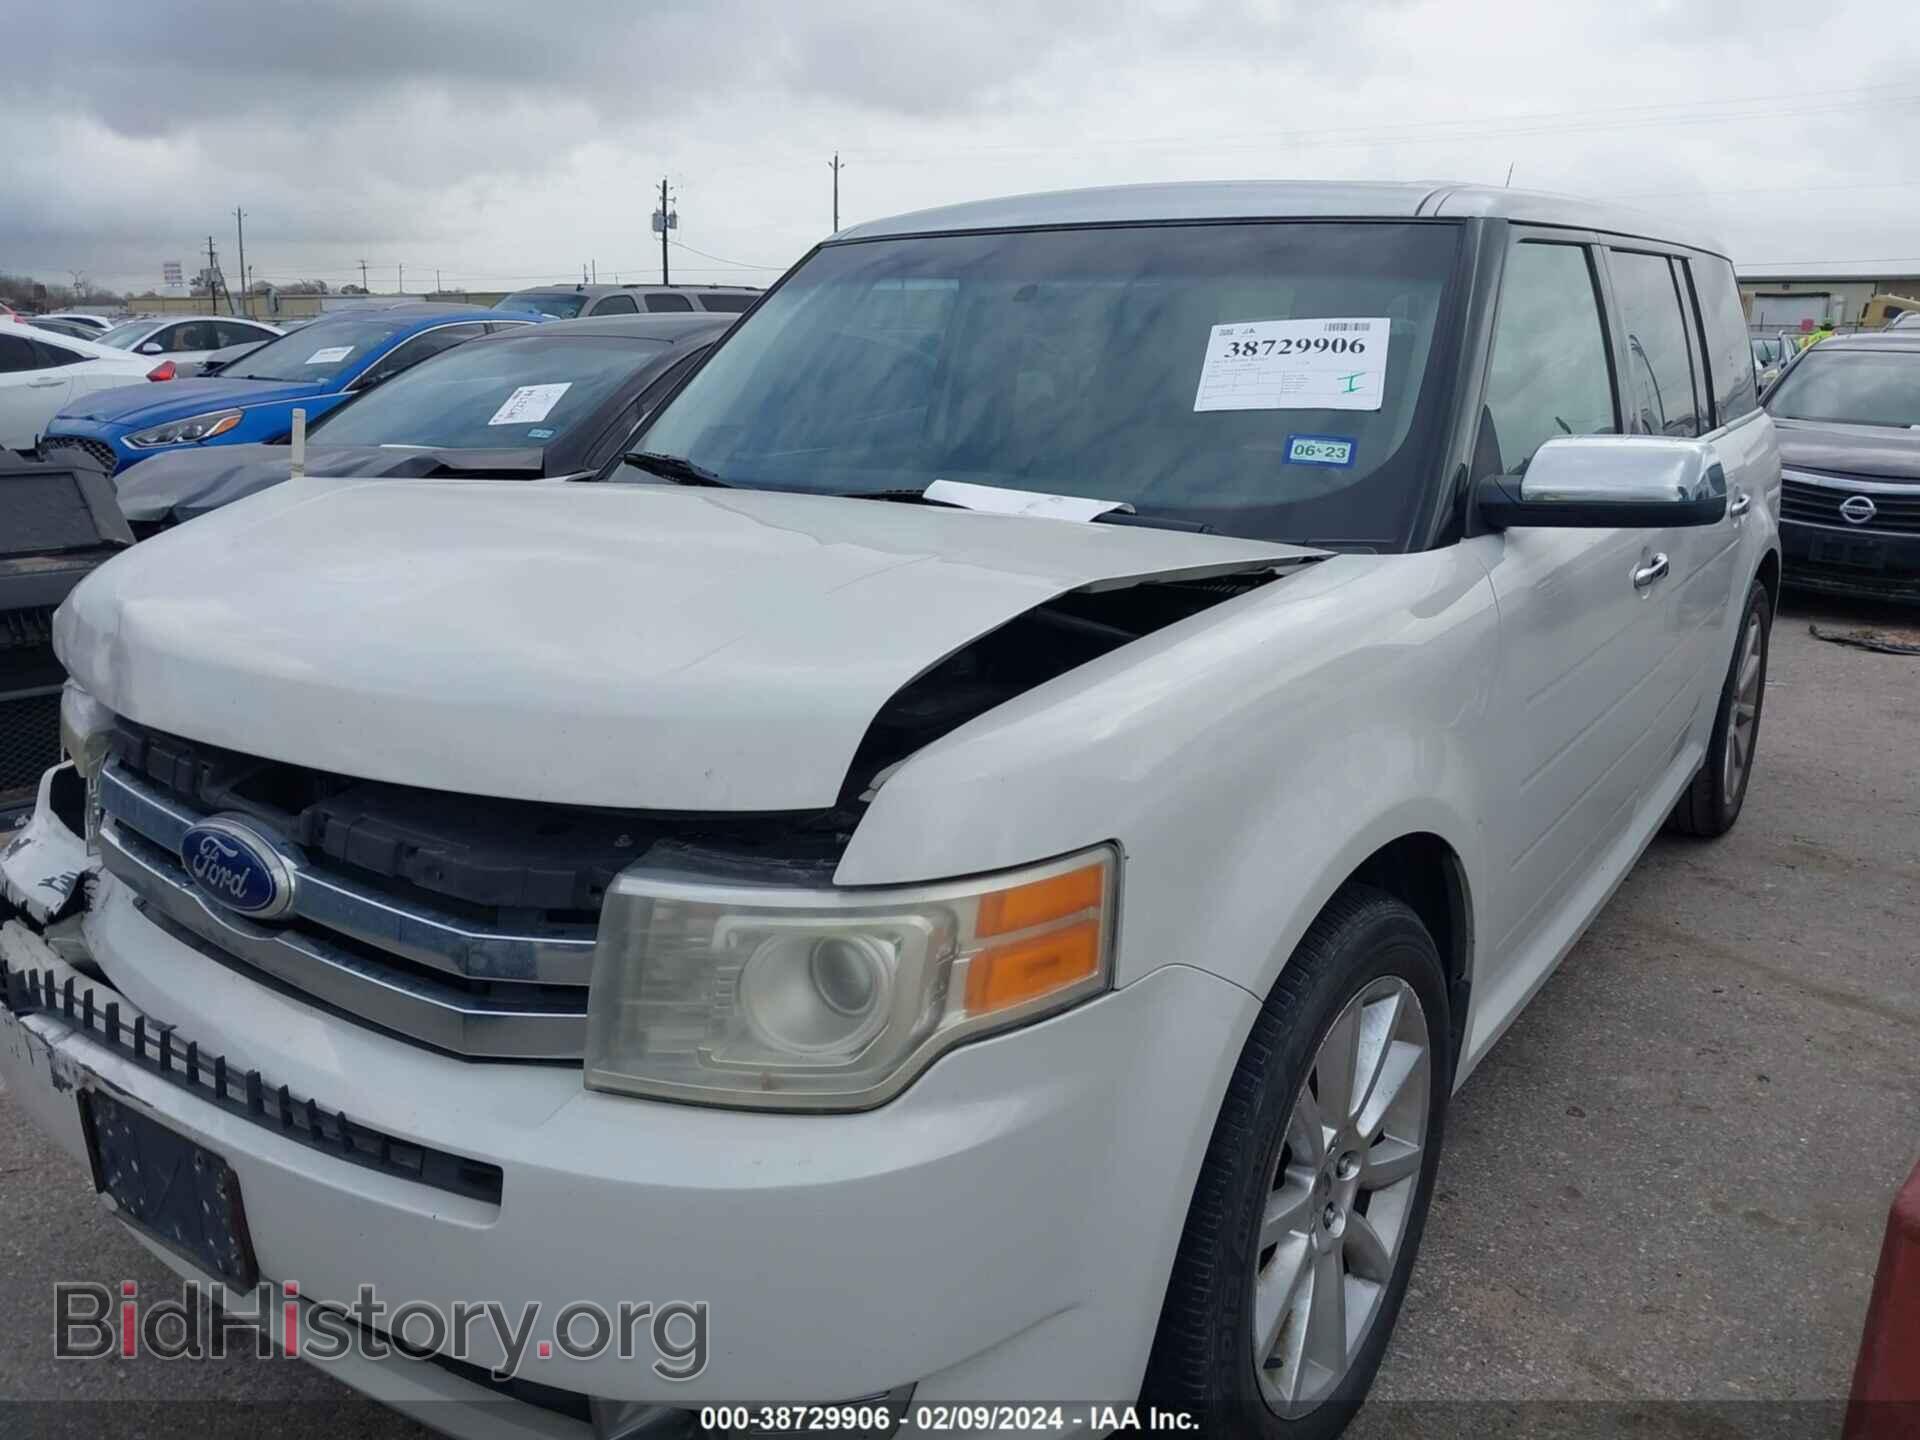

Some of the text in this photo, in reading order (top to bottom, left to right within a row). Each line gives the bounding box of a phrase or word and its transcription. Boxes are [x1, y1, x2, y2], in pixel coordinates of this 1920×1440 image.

[1224, 337, 1366, 358] 38729906
[1294, 444, 1347, 459] 06 23
[192, 836, 251, 898] Ford
